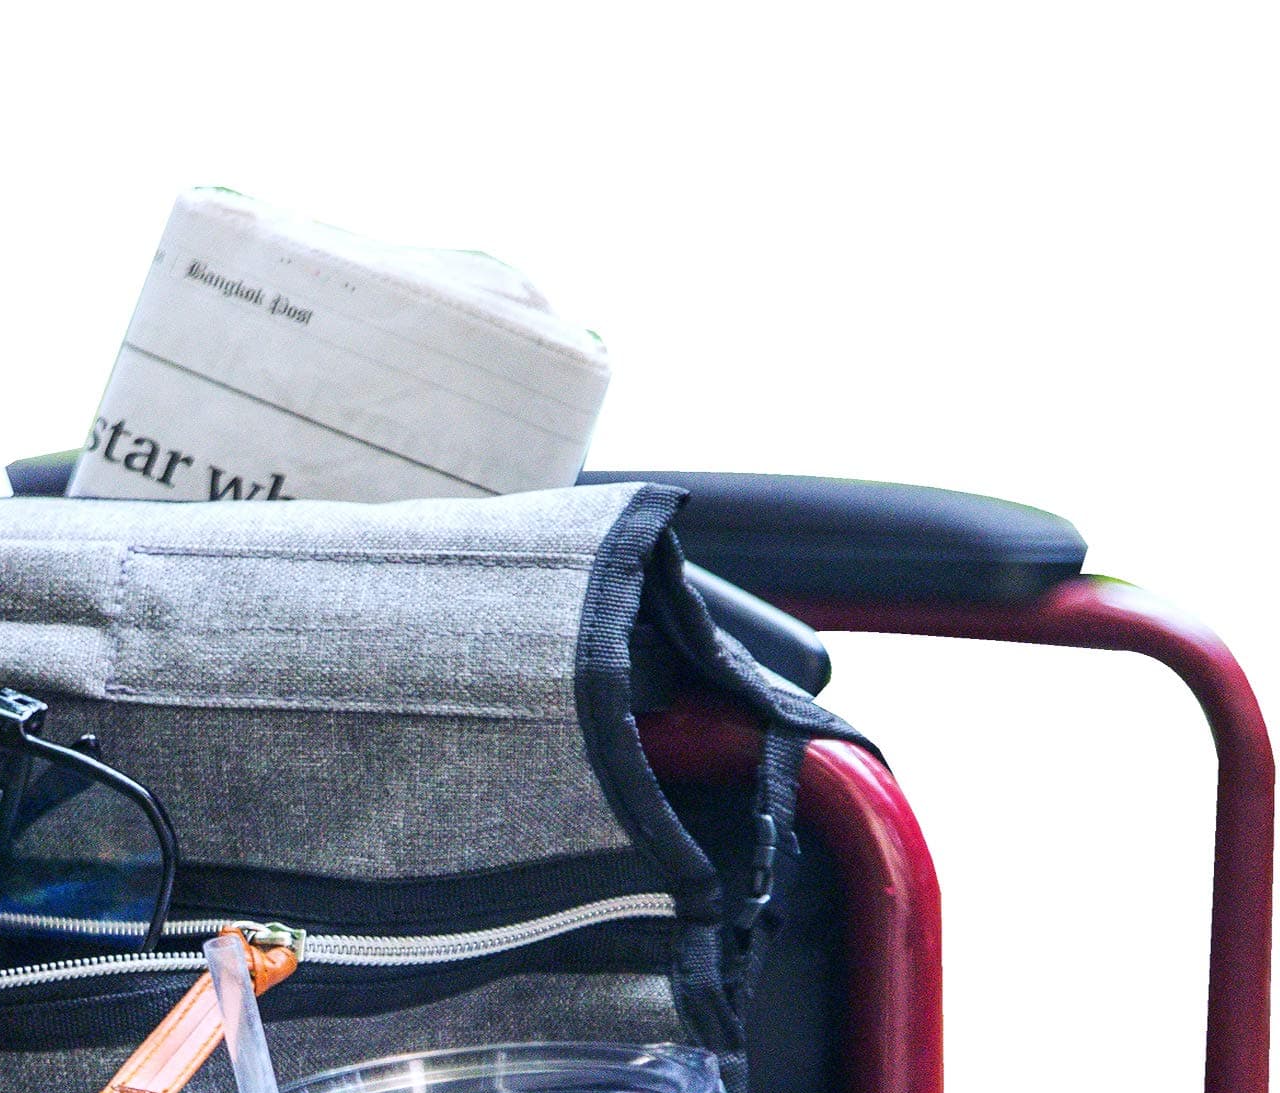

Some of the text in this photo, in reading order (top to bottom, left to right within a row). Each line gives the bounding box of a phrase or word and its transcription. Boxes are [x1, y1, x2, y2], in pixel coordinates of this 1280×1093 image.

[185, 259, 313, 326] Bangkok Post
[87, 415, 194, 489] star
